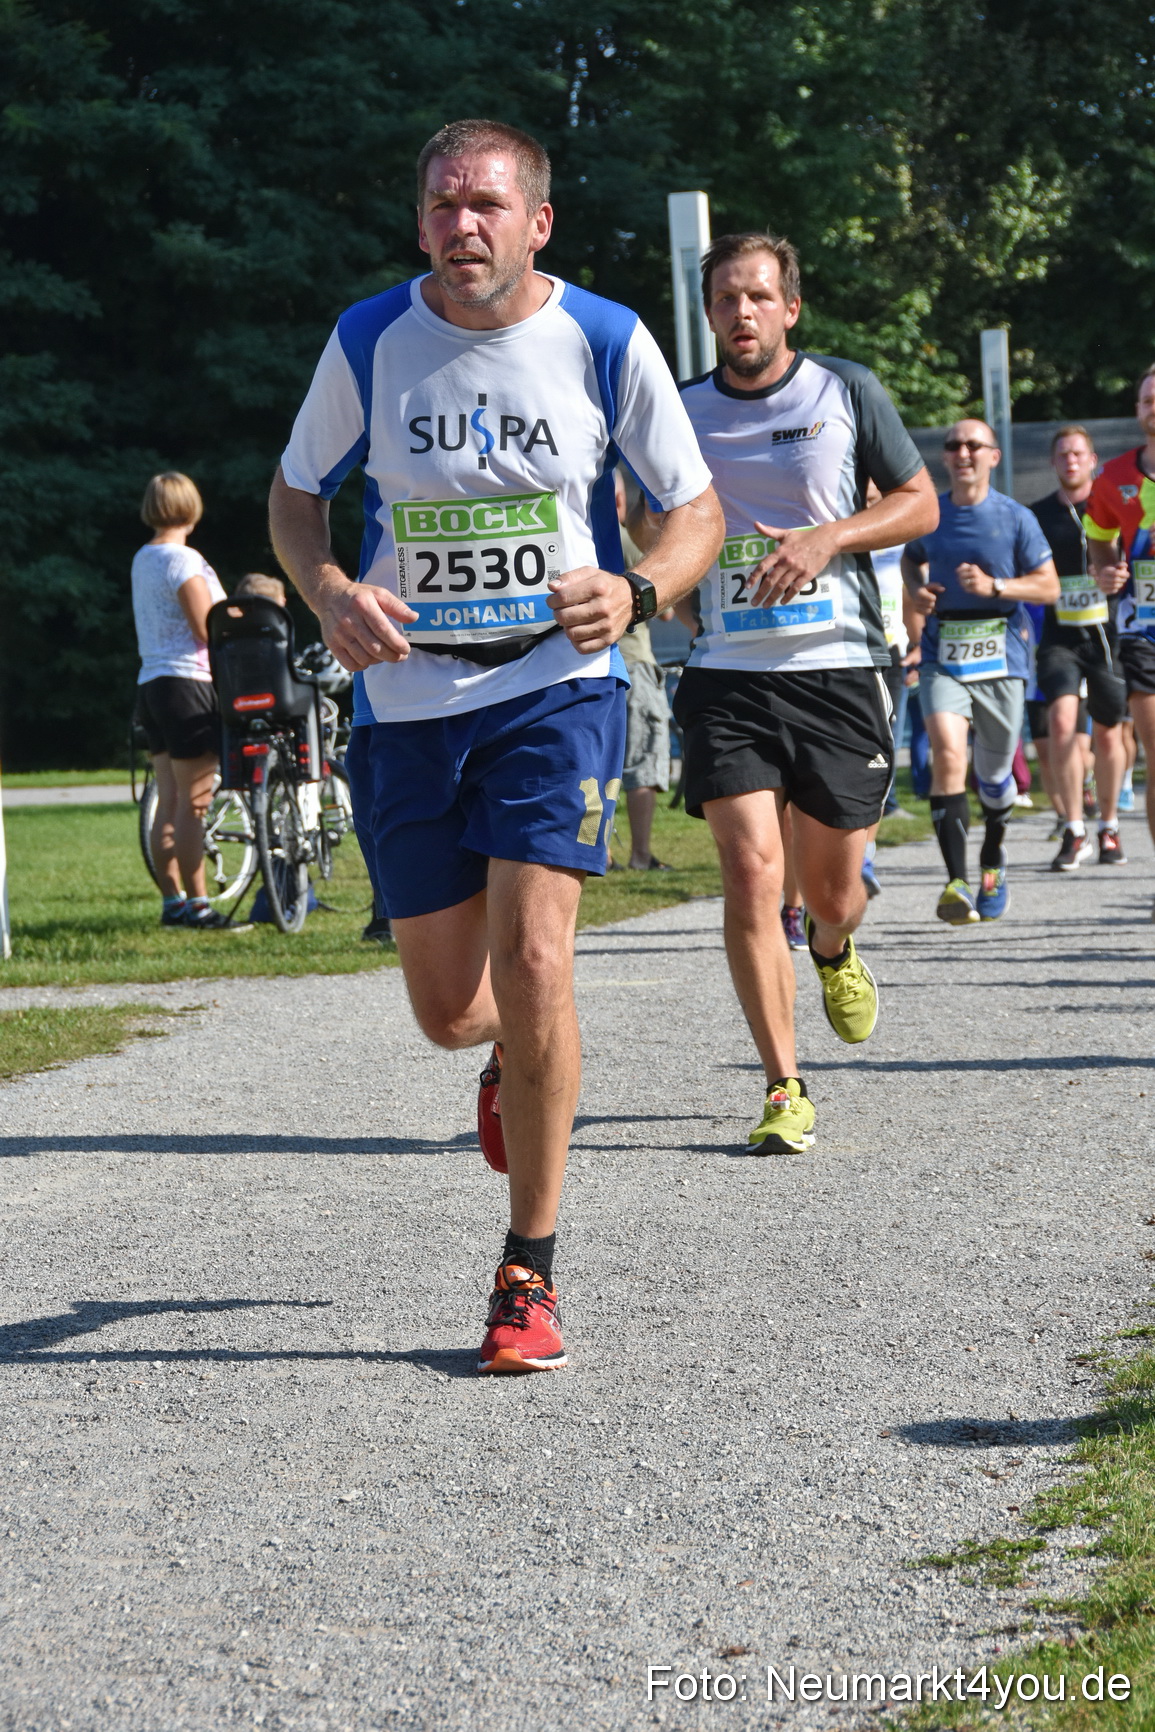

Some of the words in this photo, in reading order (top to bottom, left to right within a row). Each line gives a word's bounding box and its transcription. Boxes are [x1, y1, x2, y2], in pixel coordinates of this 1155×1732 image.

[408, 393, 559, 469] SUSPA
[772, 428, 808, 441] swn
[405, 499, 547, 536] BOCK
[415, 544, 546, 593] 2530
[429, 602, 536, 627] JOHANN
[740, 611, 800, 628] Fabian
[947, 640, 997, 660] 2789
